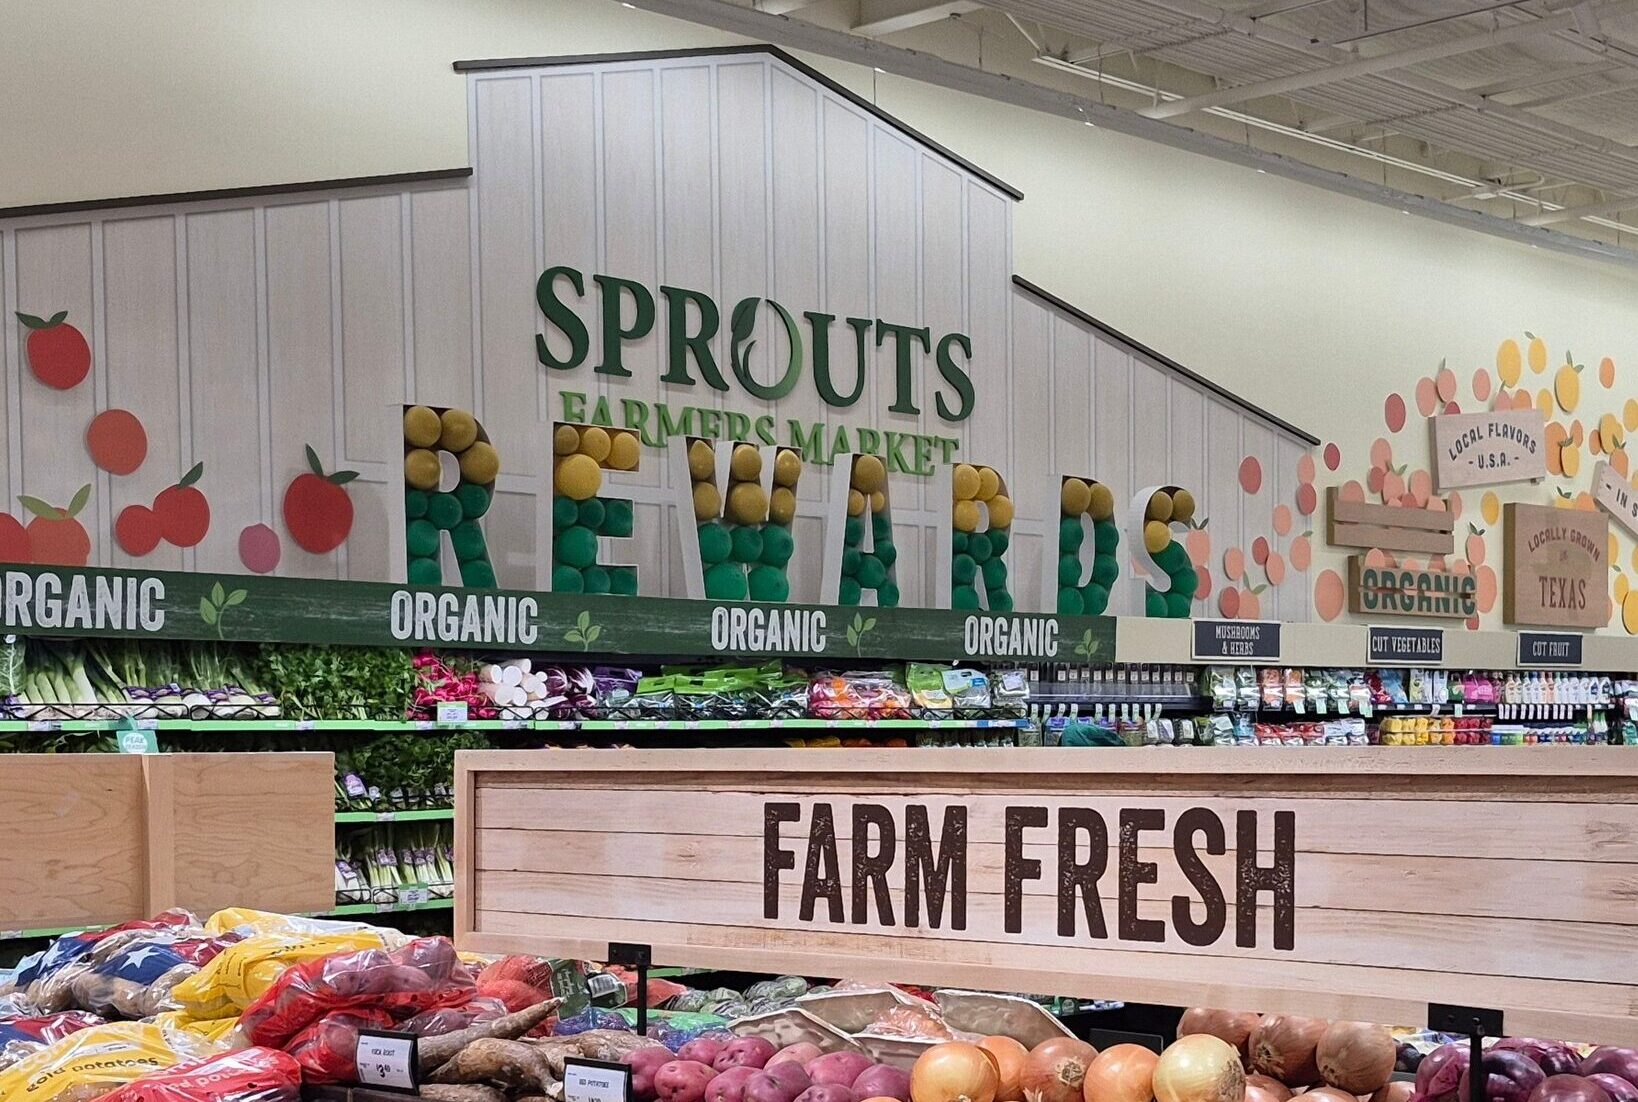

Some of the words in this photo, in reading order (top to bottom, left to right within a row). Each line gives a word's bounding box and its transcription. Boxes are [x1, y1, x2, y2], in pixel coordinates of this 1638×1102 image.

[536, 266, 976, 422] SPROUTS
[788, 419, 959, 477] MARKET
[1449, 426, 1483, 461] LOCAL
[1488, 422, 1537, 454] FLAVORS
[392, 403, 1199, 618] REWARDS
[1528, 527, 1567, 553] LOCALLY
[1570, 529, 1600, 563] GROWN
[0, 571, 165, 632] RGANIC
[1363, 568, 1476, 615] ORGANIC
[1539, 575, 1586, 610] TEXAS
[390, 590, 538, 645] ORGANIC
[711, 605, 827, 652] ORGANIC
[964, 615, 1059, 658] ORGANIC
[1215, 625, 1261, 640] MUSHROOMS
[1221, 641, 1228, 655] &
[1230, 641, 1254, 656] HERBS
[1372, 636, 1389, 652] CUT
[1391, 636, 1441, 654] VEGETABLES
[1532, 641, 1548, 657] CUT
[1549, 641, 1571, 657] FRUIT
[763, 802, 967, 931] FARM
[1004, 806, 1295, 951] FRESH
